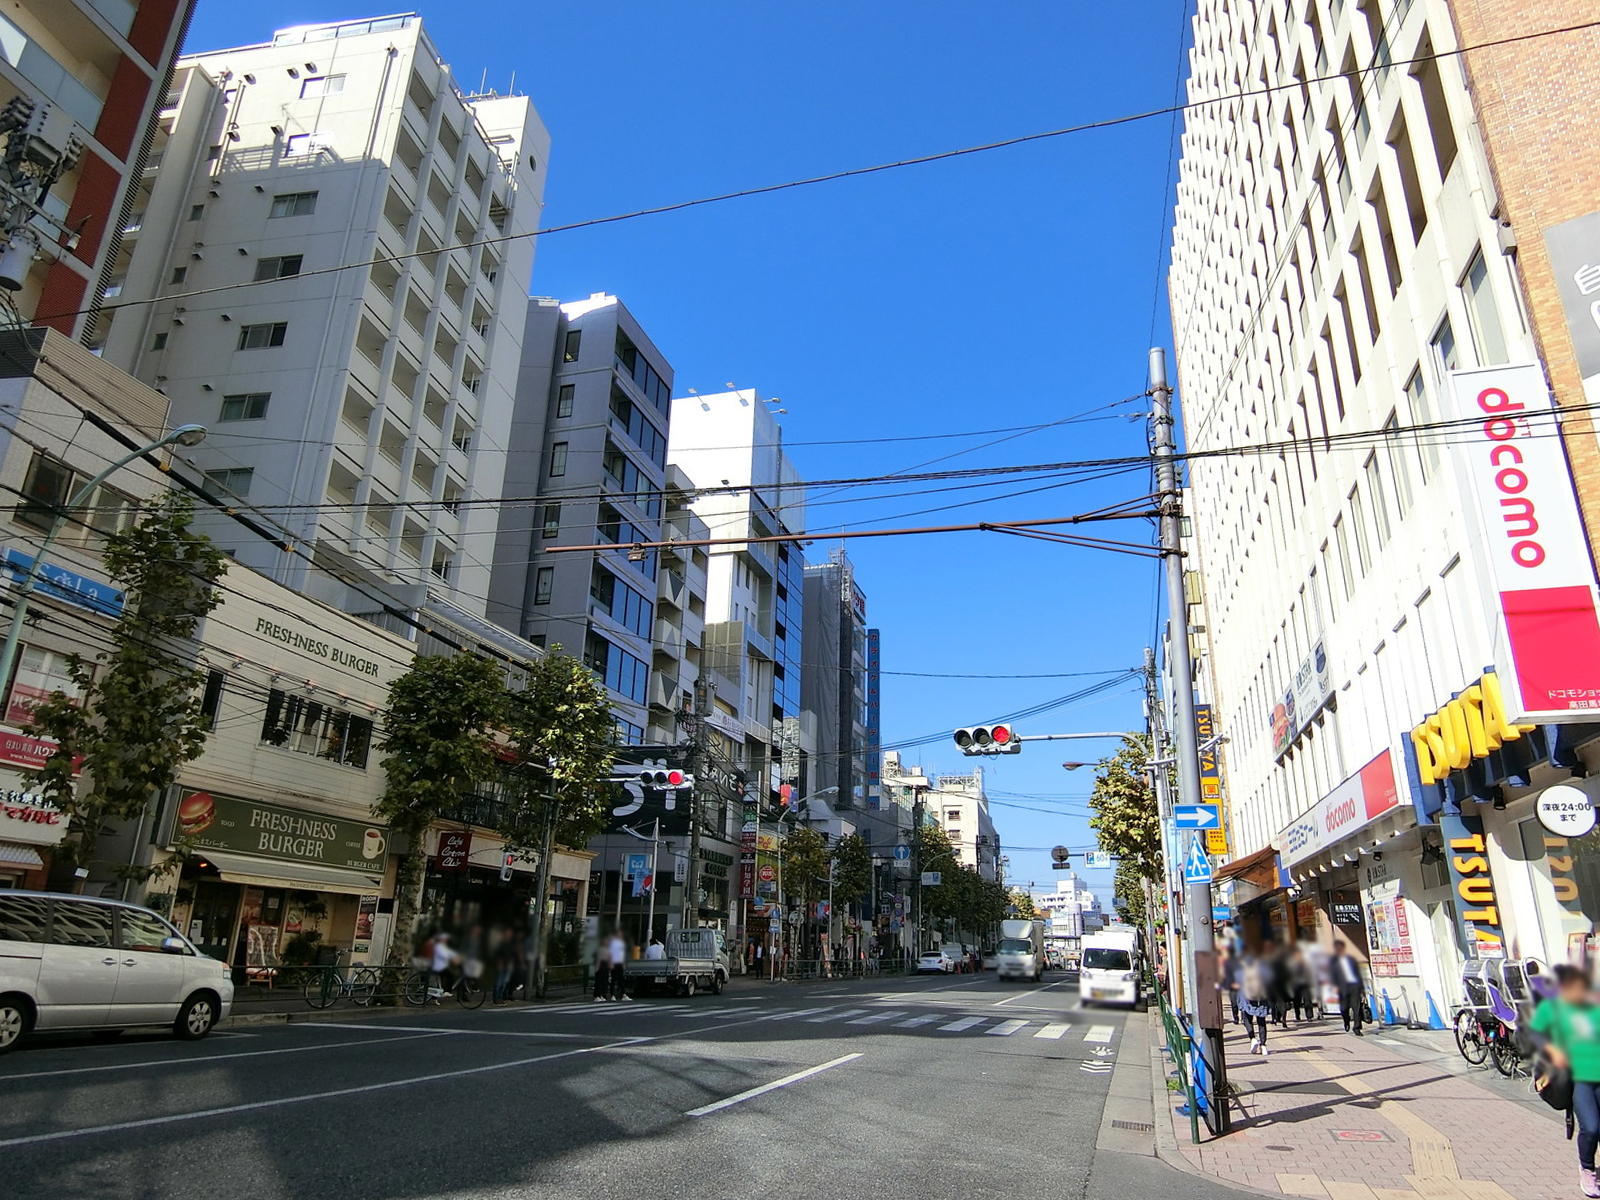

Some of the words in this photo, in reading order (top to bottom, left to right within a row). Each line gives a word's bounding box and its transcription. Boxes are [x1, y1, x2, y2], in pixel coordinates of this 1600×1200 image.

[1518, 414, 1532, 438] NTT
[1477, 387, 1546, 569] docomo
[255, 617, 328, 659] FRESHNESS
[332, 648, 379, 678] BURGER
[1197, 709, 1215, 772] TSUYA
[1411, 672, 1536, 786] TSUTA
[1325, 798, 1356, 833] docomo
[1543, 803, 1591, 812] 深夜24:00
[1560, 814, 1577, 822] まで
[250, 808, 338, 841] FRESHNESS
[258, 832, 324, 858] BURGER
[347, 859, 367, 868] BURGER
